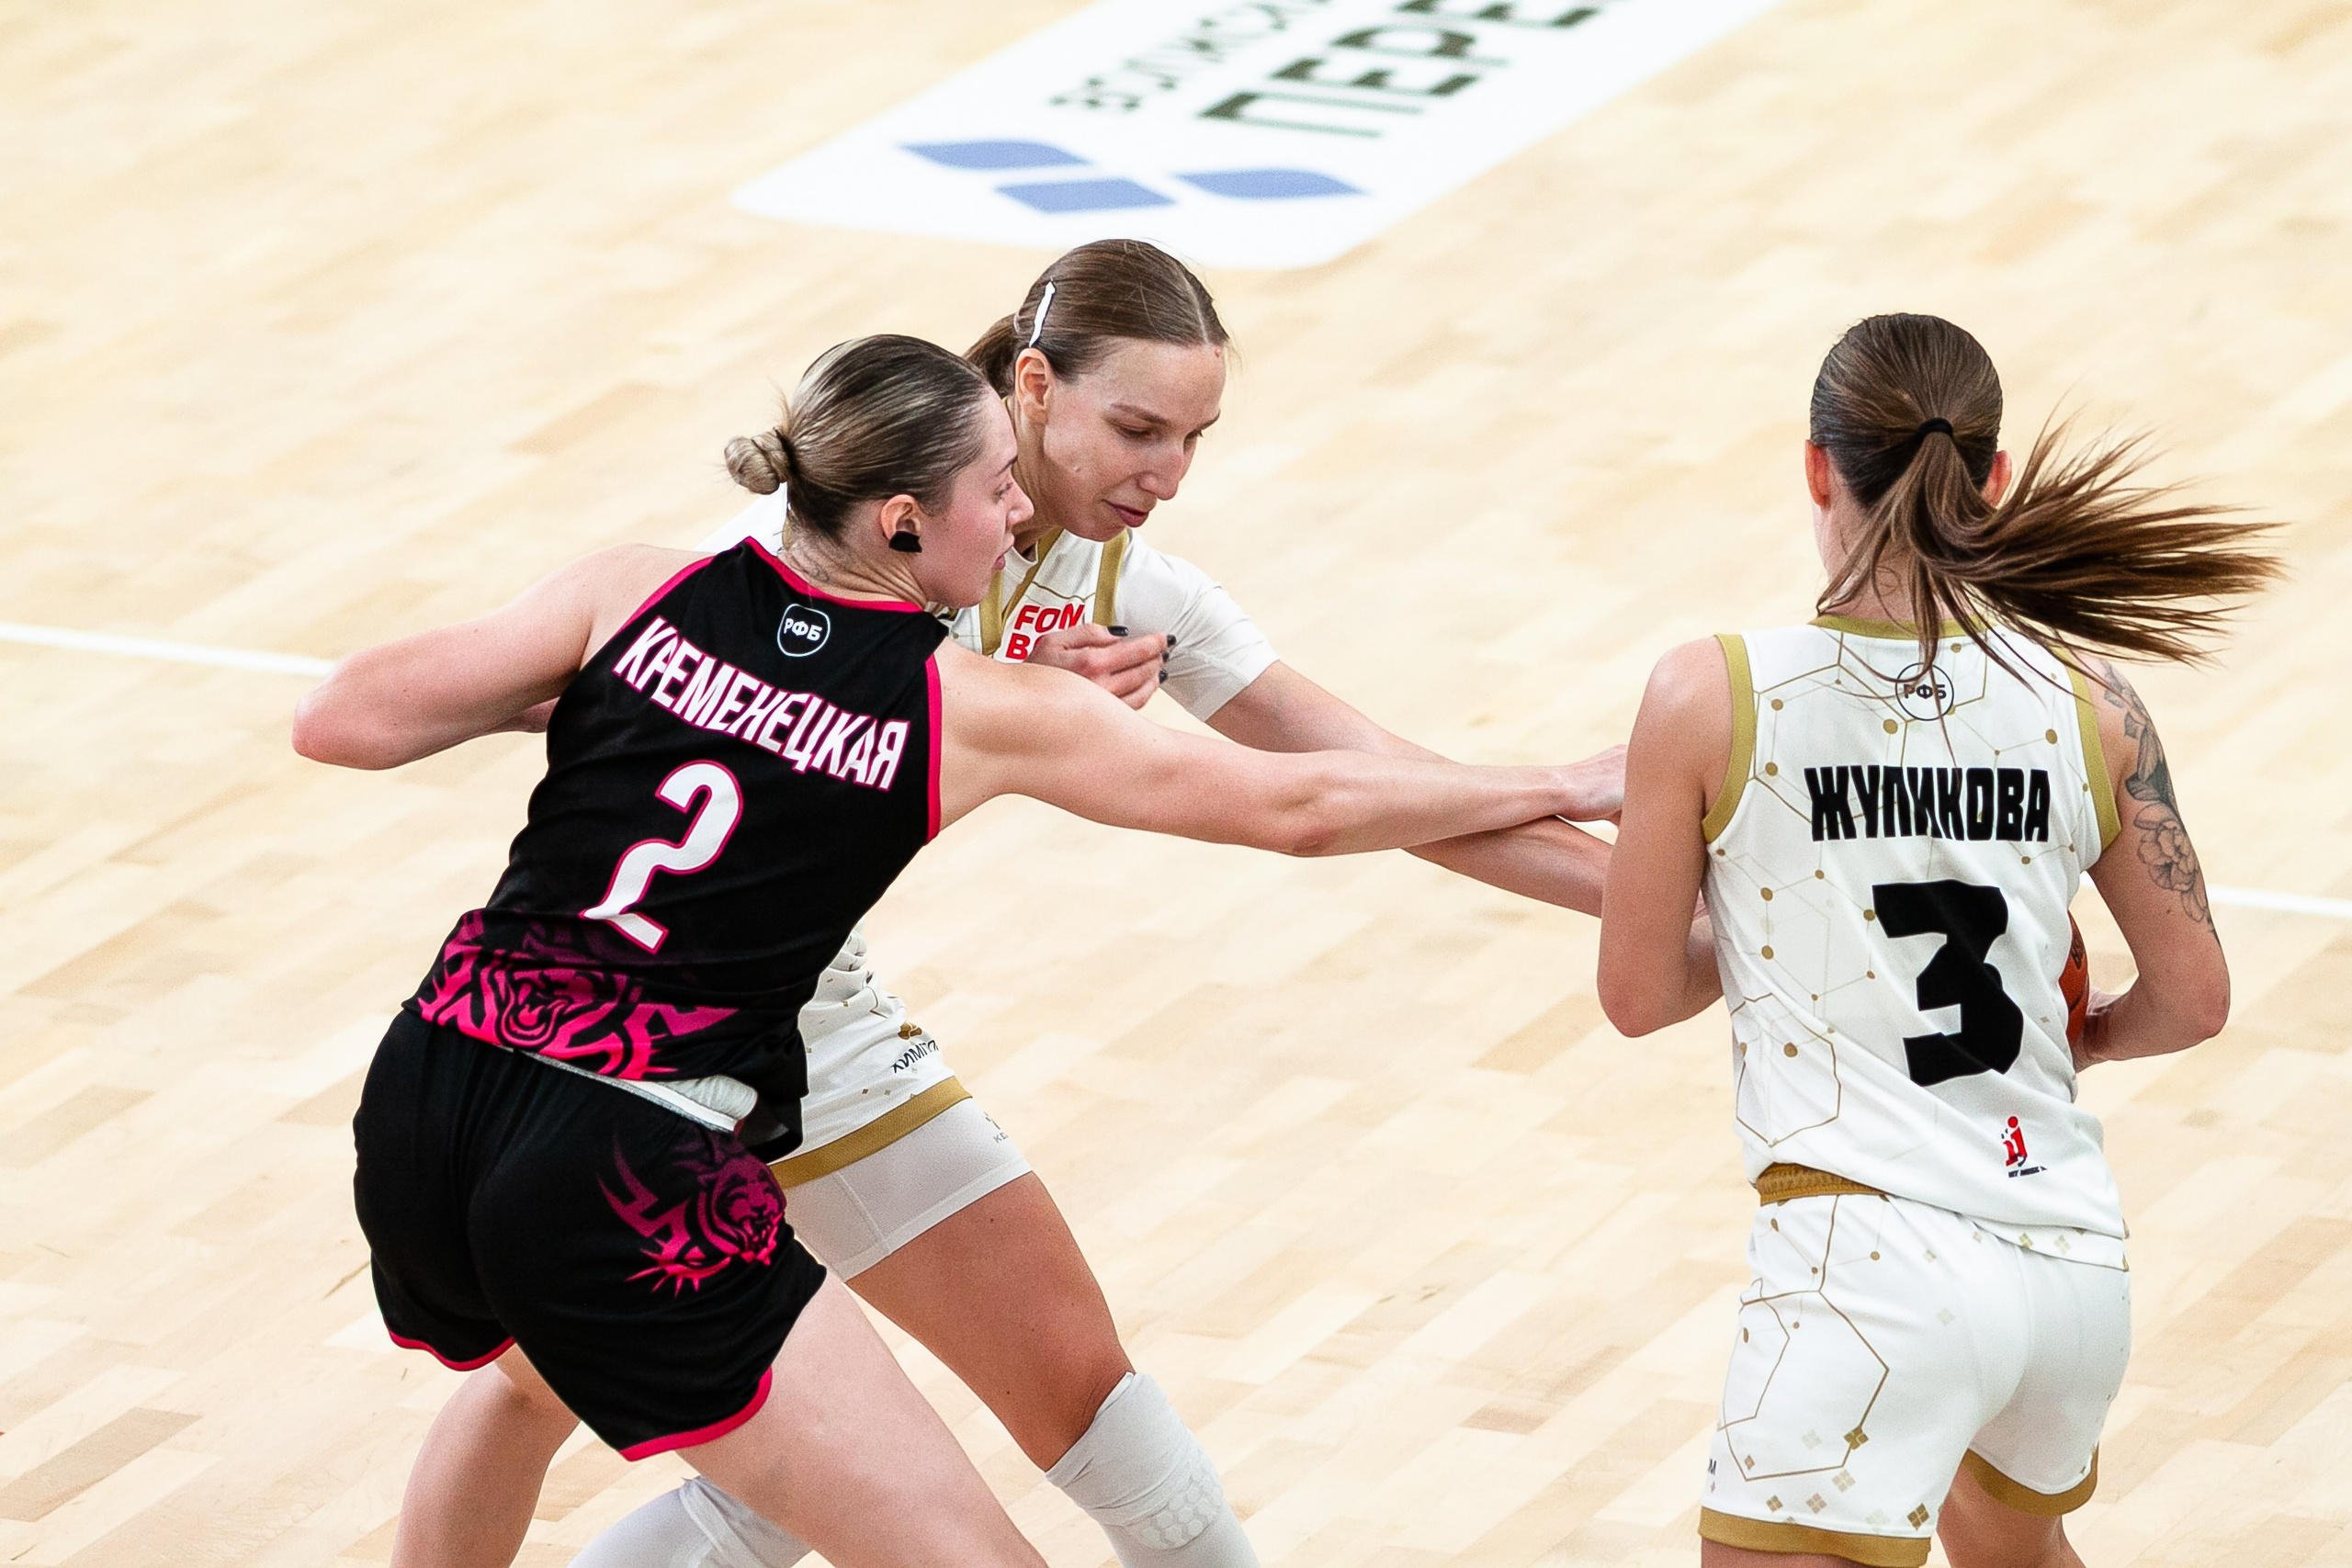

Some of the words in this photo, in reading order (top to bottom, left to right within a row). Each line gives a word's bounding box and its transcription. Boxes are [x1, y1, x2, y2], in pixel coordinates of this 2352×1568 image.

[1193, 0, 1612, 138] ПЕРЕ
[784, 617, 823, 641] РФБ
[1013, 603, 1085, 633] FON
[611, 615, 910, 792] КРЕМЕНЕЦКАЯ
[1903, 683, 1947, 699] РФБ
[581, 759, 744, 954] 2
[1804, 764, 2051, 842] ЖУЛИКОВА
[1871, 879, 2024, 1087] 3
